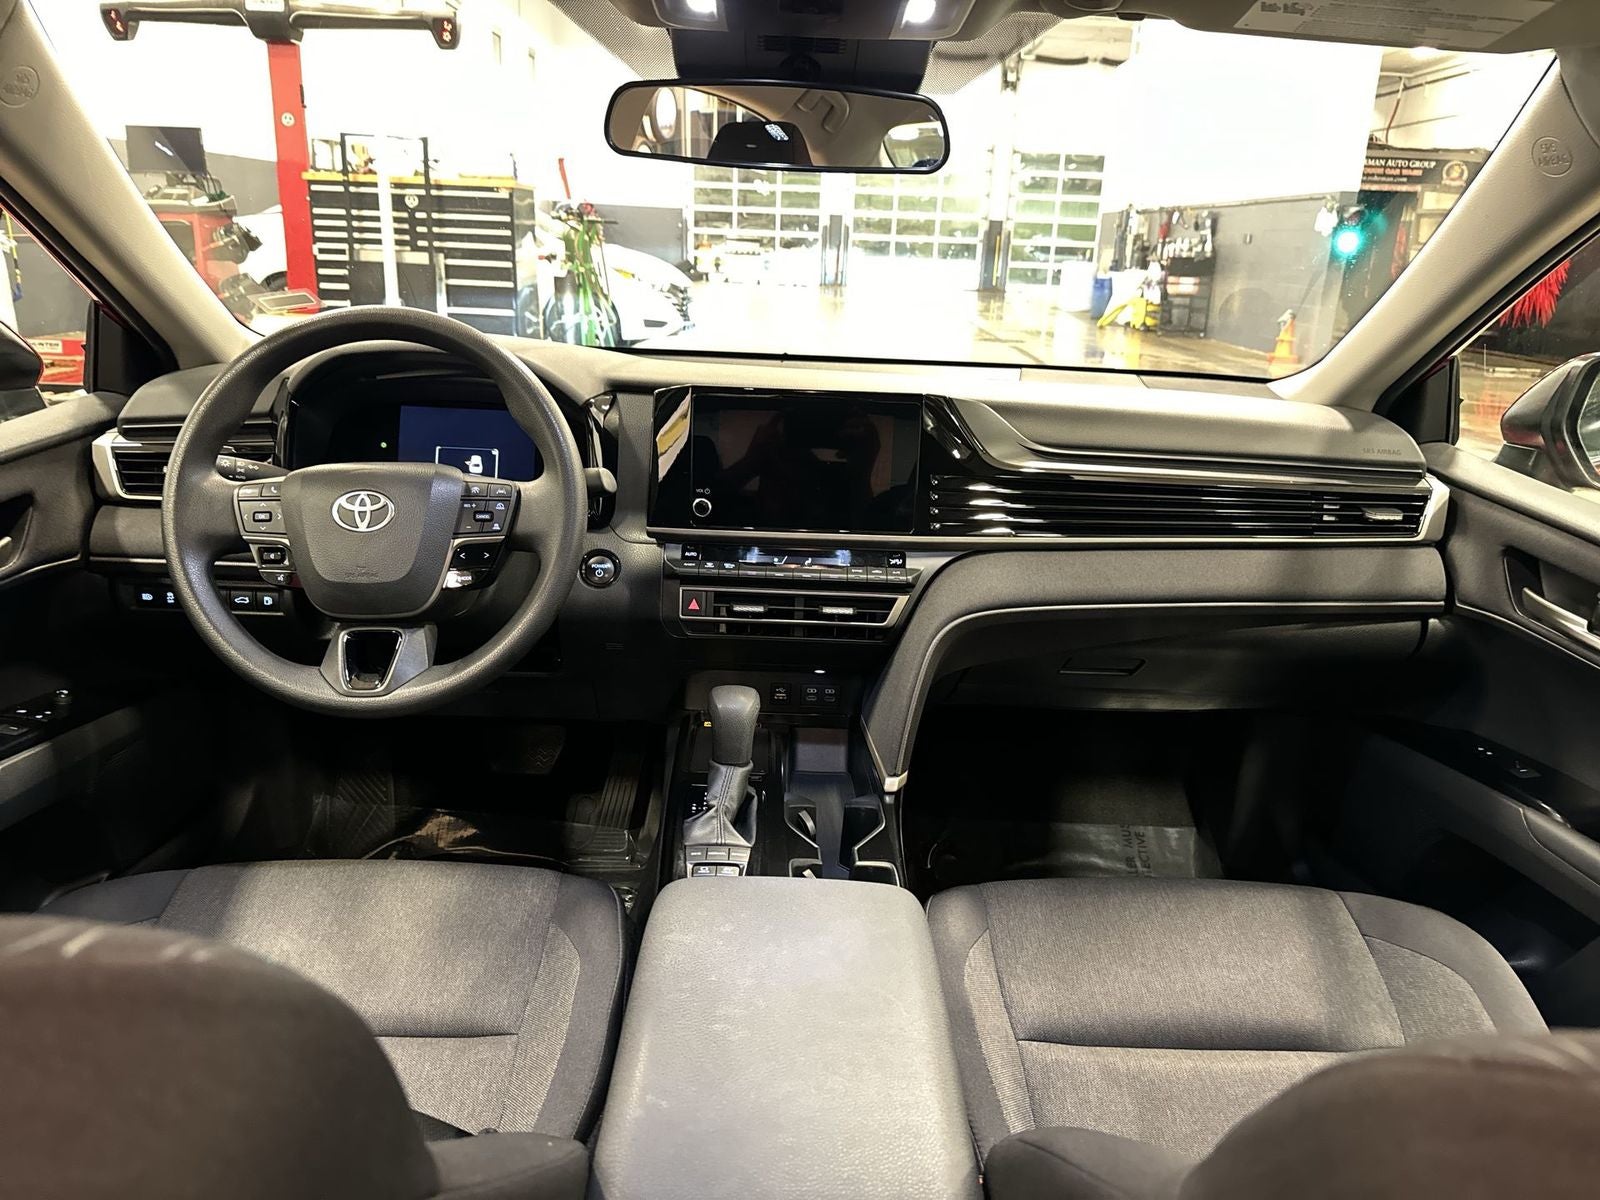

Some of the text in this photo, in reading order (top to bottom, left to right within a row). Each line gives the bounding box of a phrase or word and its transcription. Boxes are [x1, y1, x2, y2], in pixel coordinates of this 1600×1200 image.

[1386, 159, 1409, 168] AUTO
[1409, 160, 1437, 169] GROUP
[1376, 448, 1402, 456] AIRBAG
